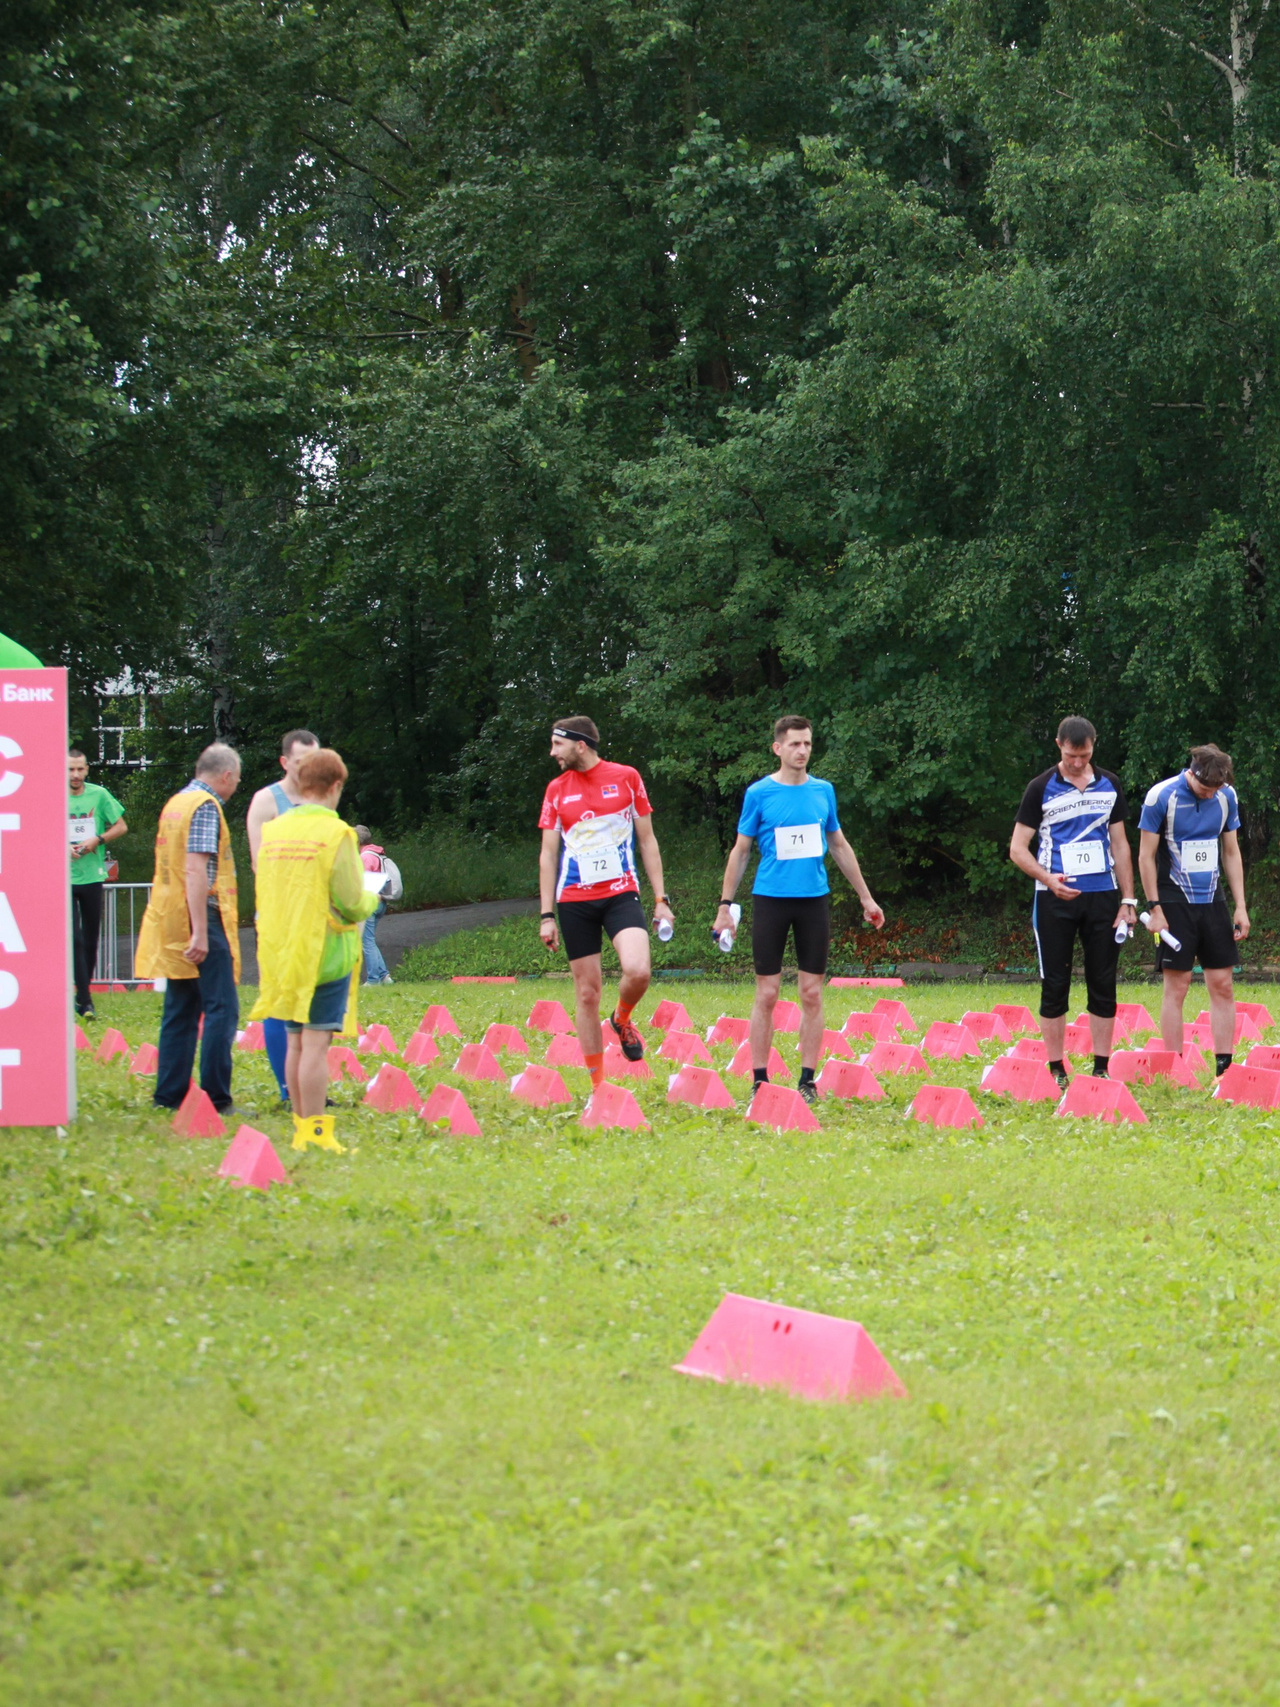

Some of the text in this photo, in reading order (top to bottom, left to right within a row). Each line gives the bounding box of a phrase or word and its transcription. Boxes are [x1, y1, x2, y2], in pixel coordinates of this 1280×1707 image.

[3, 683, 54, 702] Банк
[1048, 799, 1112, 817] ORIENTEERING
[75, 825, 86, 833] 66
[791, 834, 804, 845] 71
[1076, 853, 1090, 864] 70
[1195, 851, 1207, 862] 69
[592, 860, 607, 871] 72
